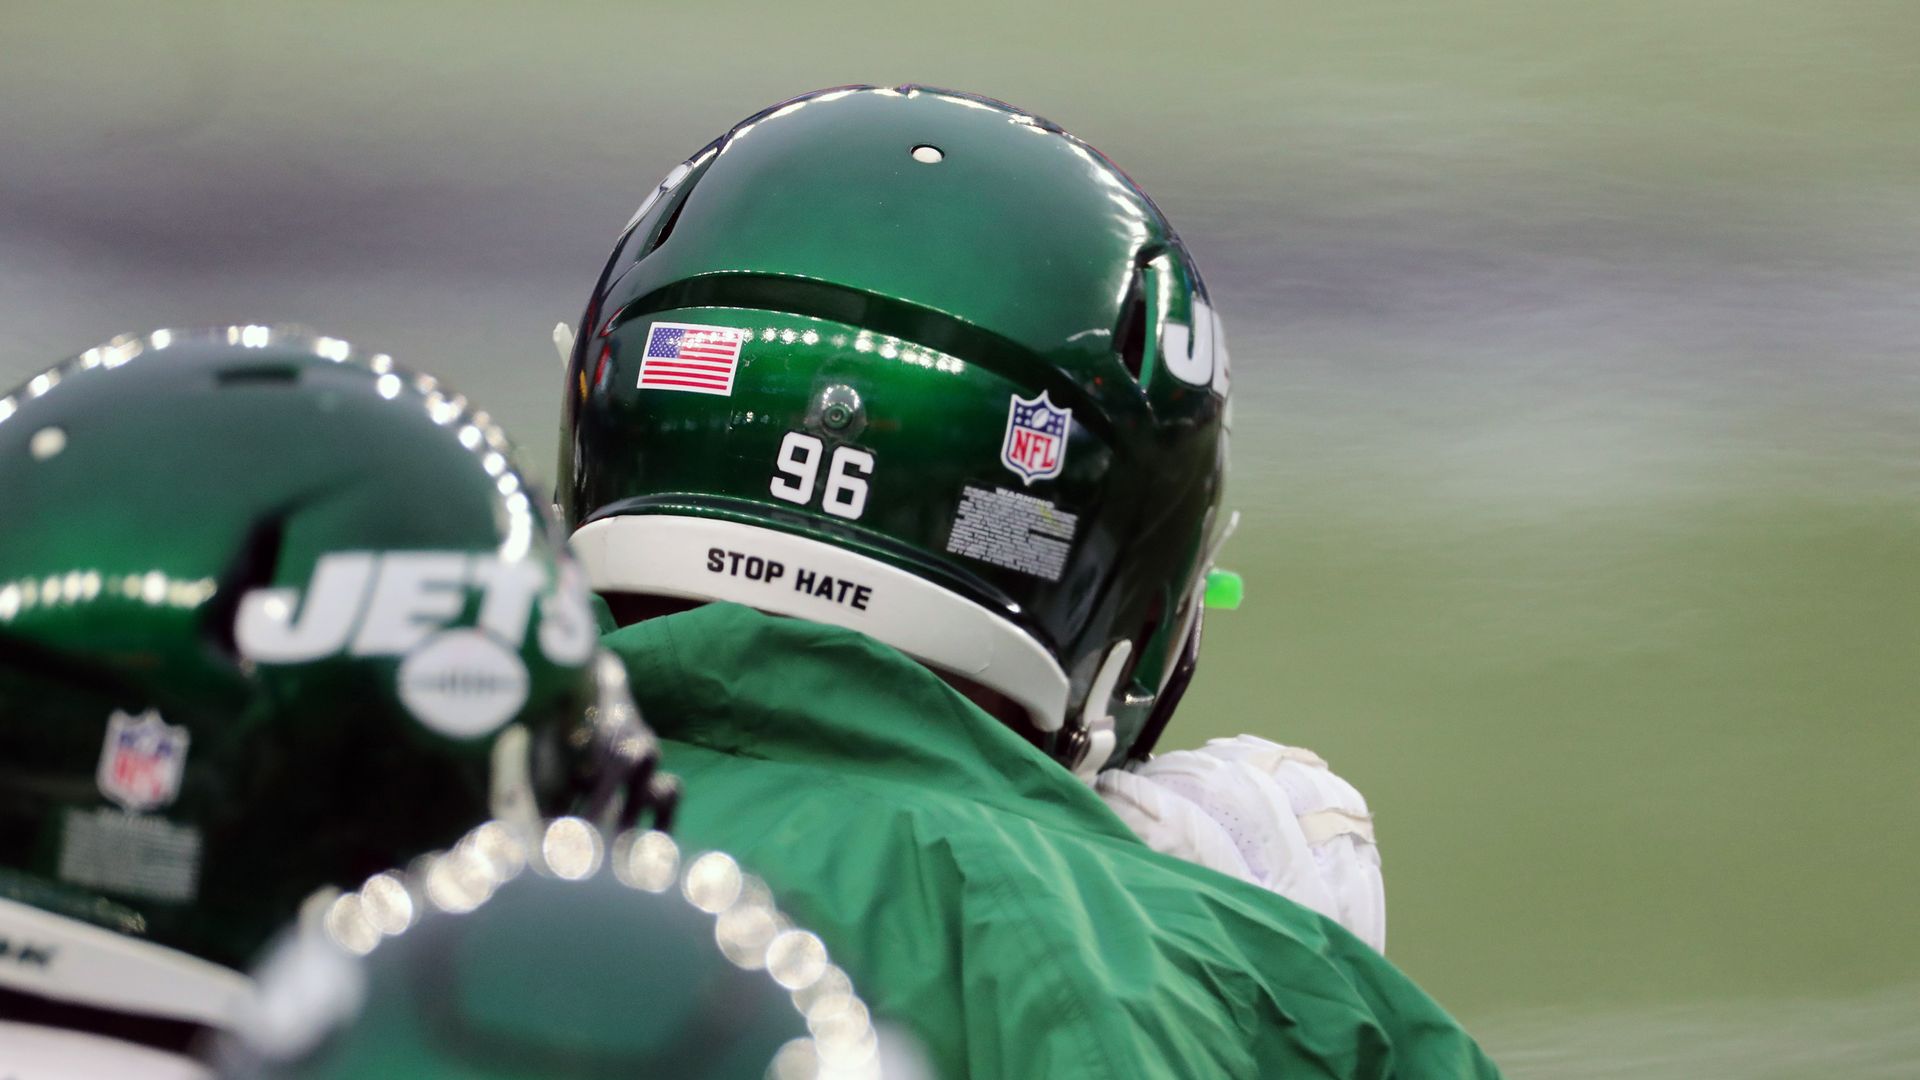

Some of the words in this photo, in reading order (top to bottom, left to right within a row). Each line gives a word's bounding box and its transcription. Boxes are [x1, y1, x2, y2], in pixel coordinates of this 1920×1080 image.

[769, 431, 875, 520] 96
[1010, 428, 1055, 469] NFL
[234, 552, 597, 667] JETS
[706, 547, 785, 583] STOP
[794, 567, 873, 611] HATE
